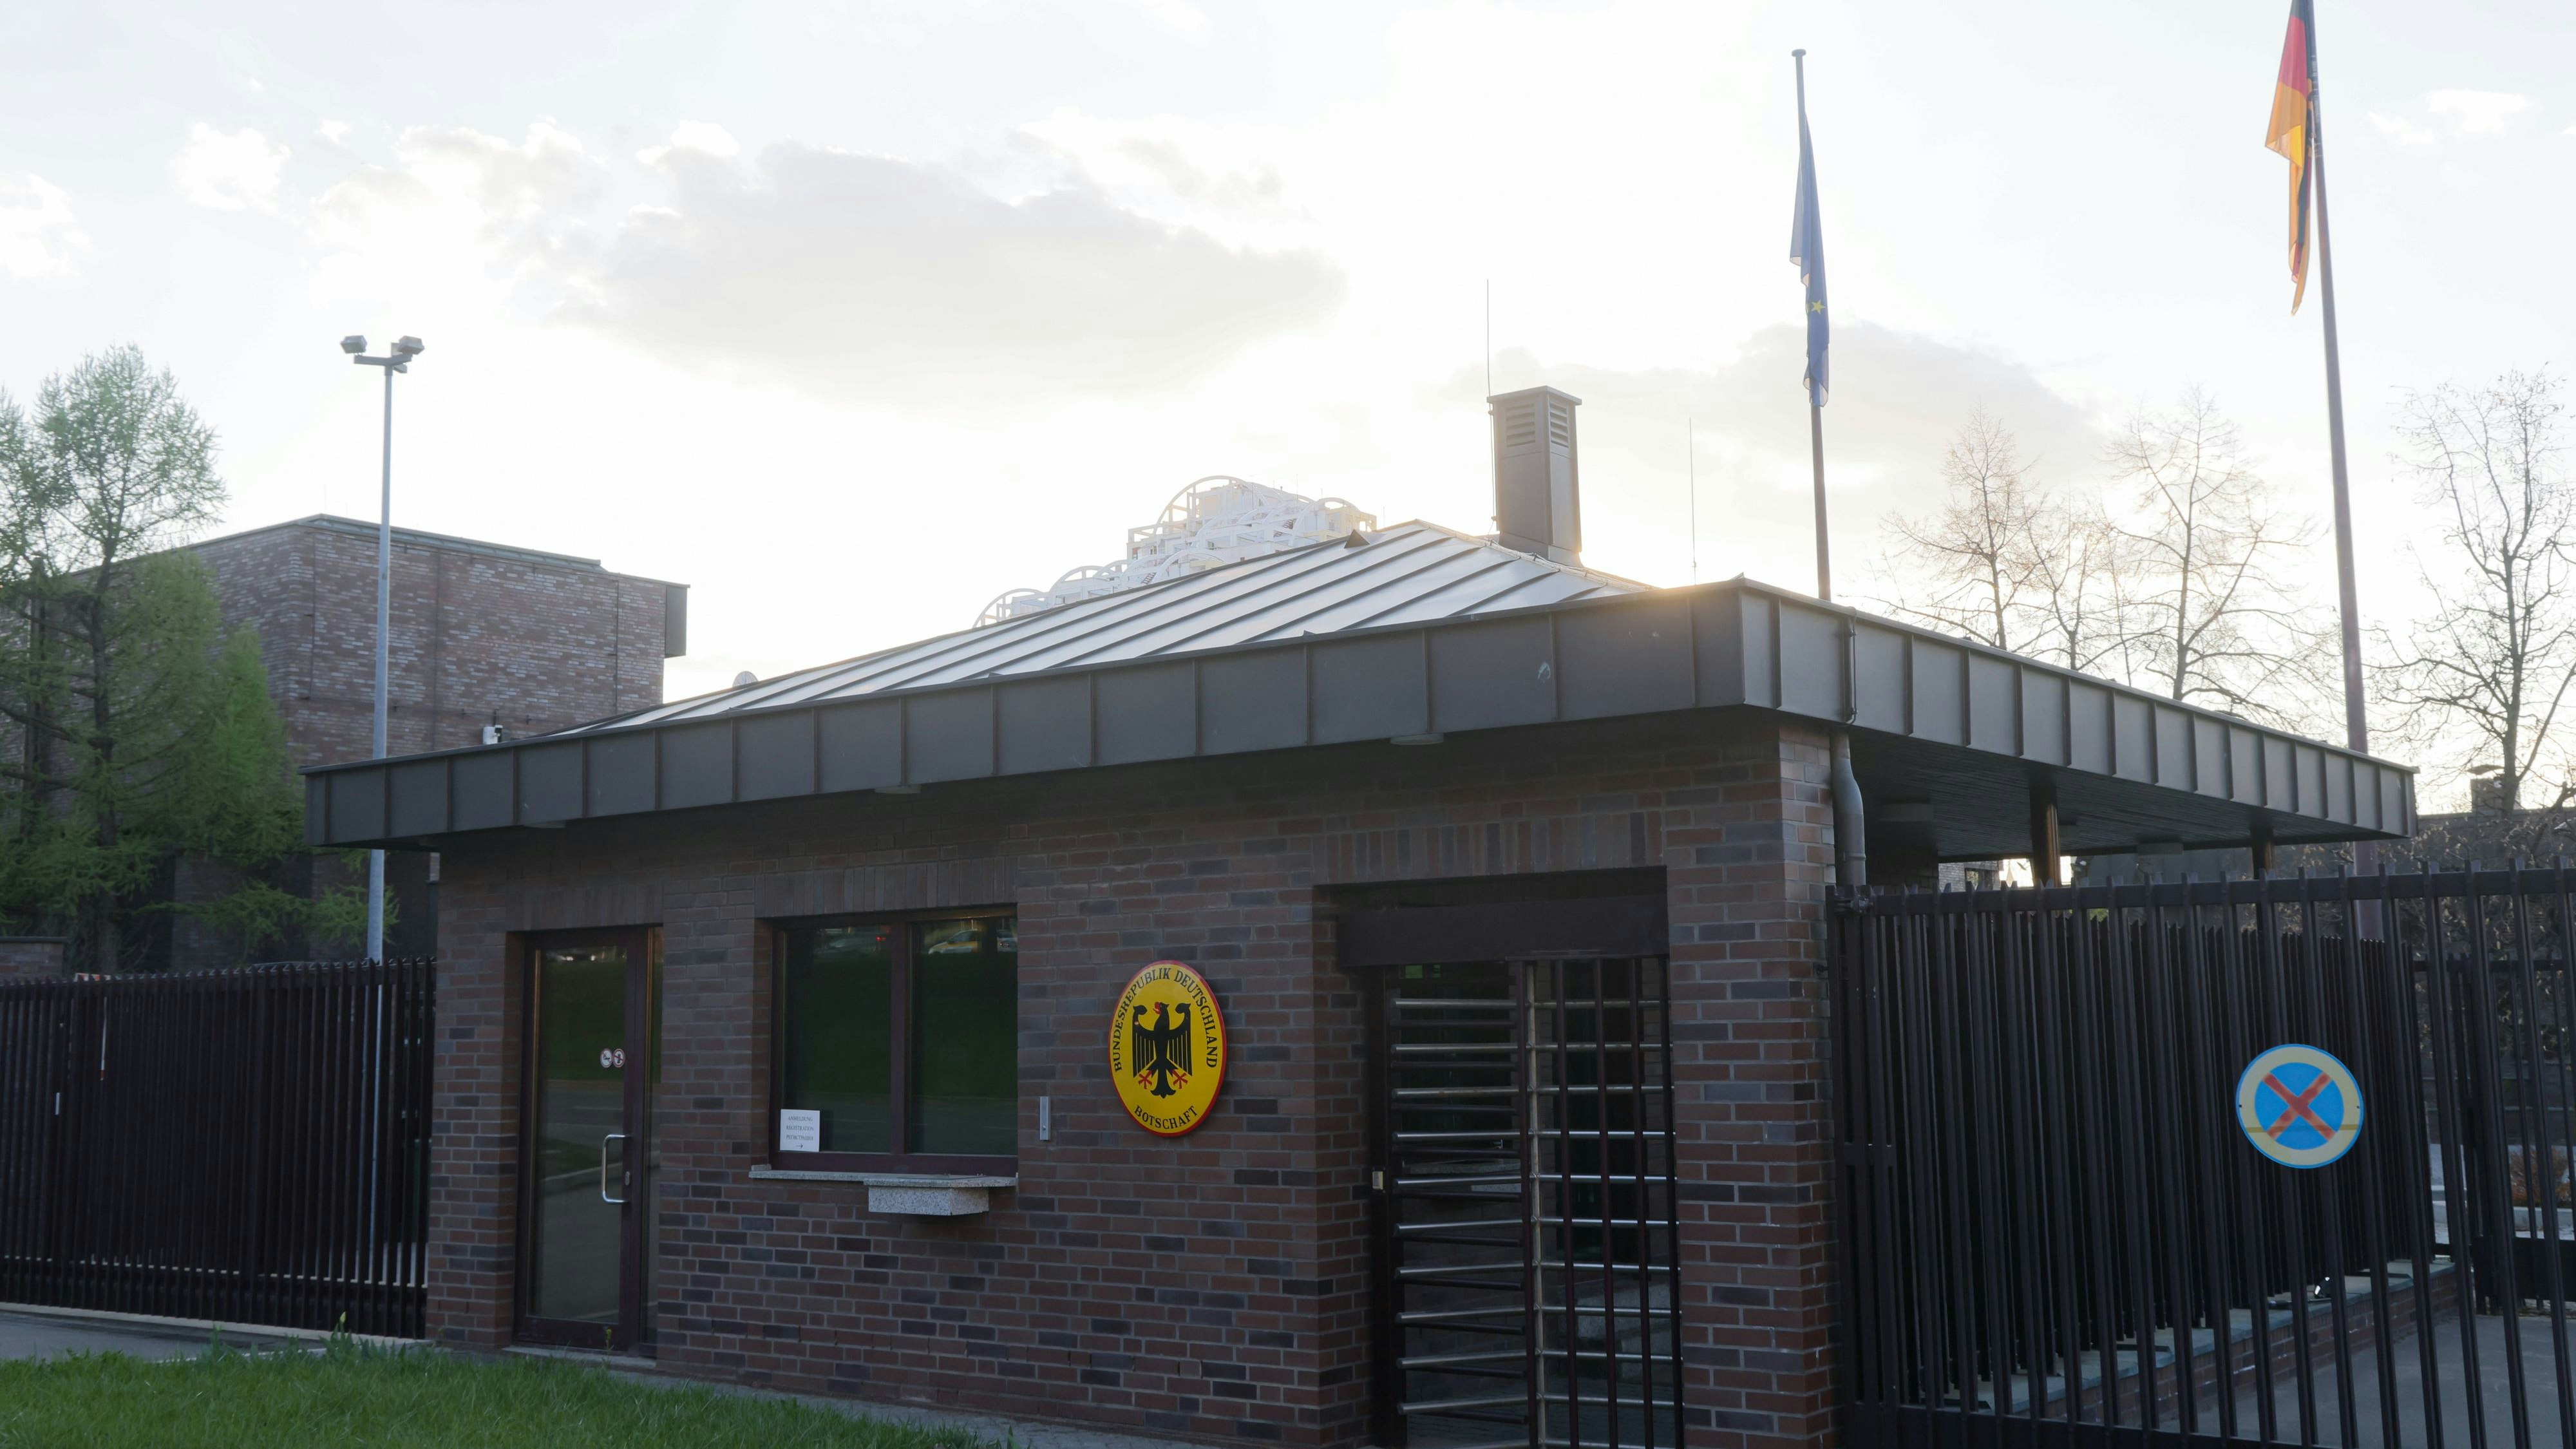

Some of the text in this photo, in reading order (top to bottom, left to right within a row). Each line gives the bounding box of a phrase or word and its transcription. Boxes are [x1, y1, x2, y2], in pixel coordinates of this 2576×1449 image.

[1113, 967, 1218, 1072] BUNDESREPUBLIK DEUTSCHLAND
[1134, 1105, 1198, 1130] BOTSCHAFT
